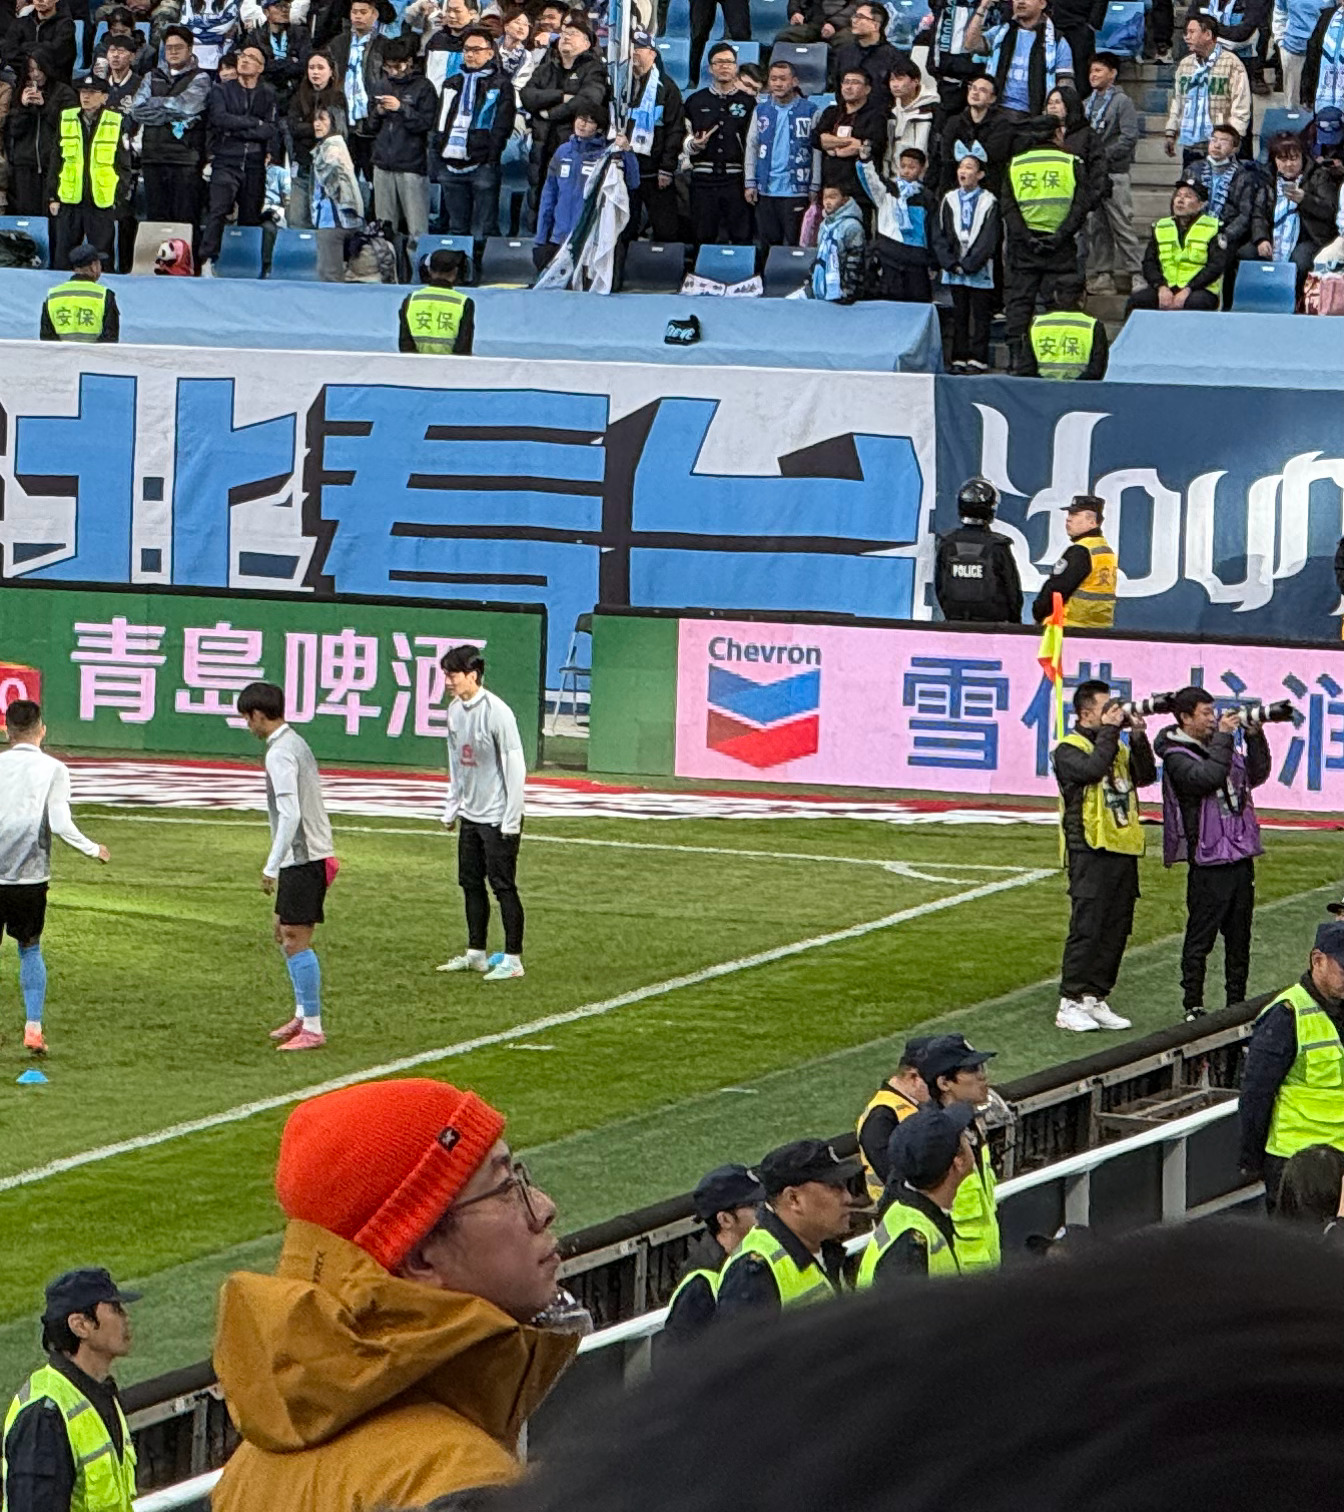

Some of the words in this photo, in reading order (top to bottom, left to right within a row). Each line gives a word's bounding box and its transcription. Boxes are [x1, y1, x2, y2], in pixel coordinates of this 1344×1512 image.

[1019, 170, 1061, 190] 安保
[54, 305, 96, 328] 安保
[414, 310, 455, 334] 安保
[1038, 334, 1081, 357] 安保
[952, 563, 984, 579] POLICE
[707, 636, 823, 666] Chevron
